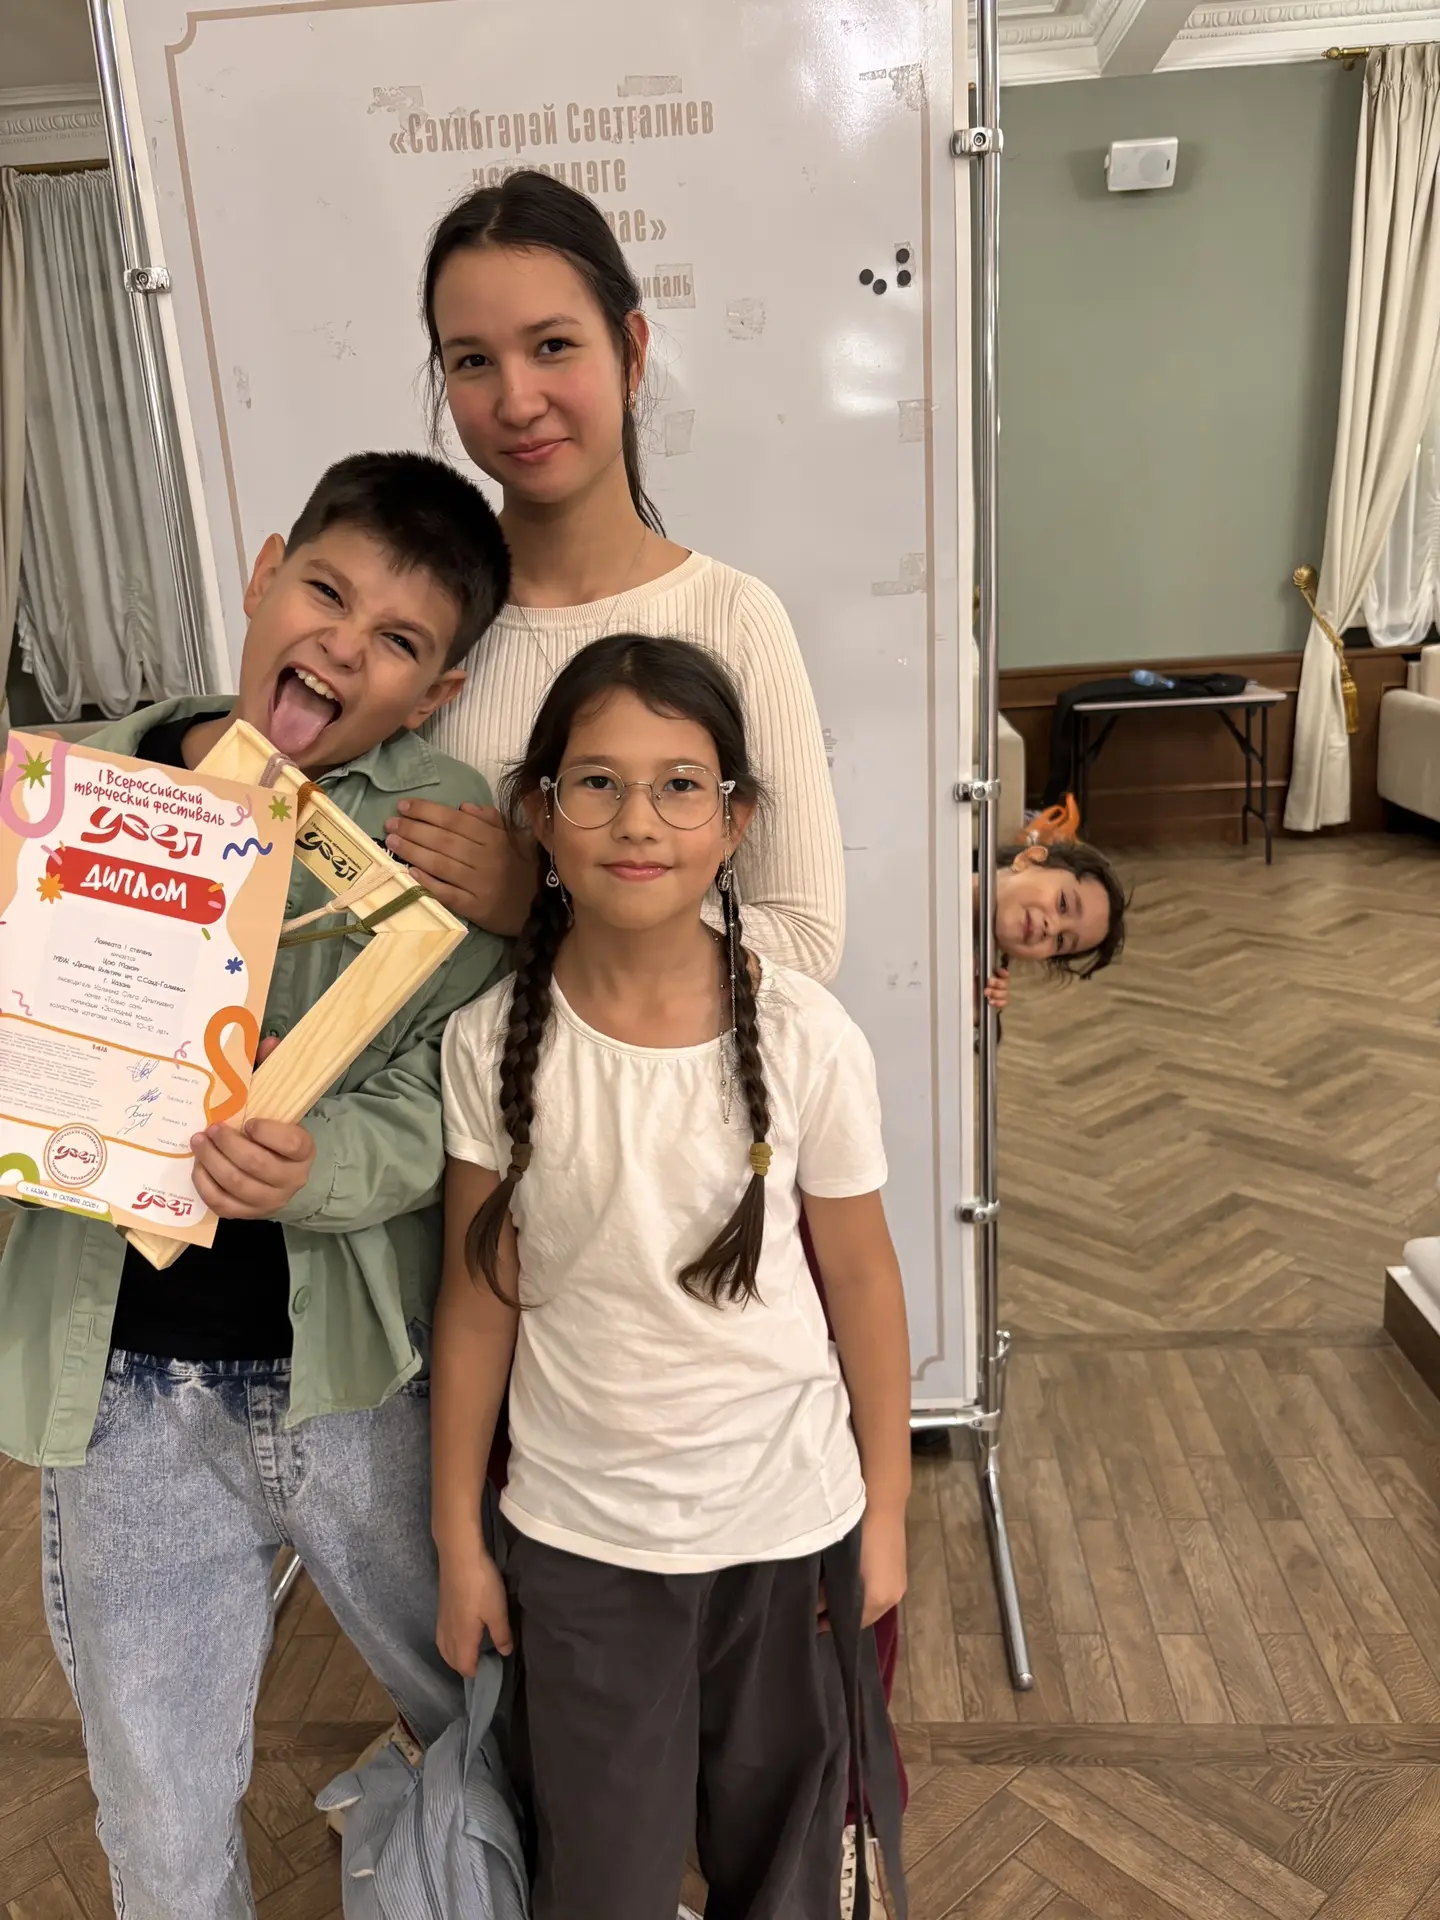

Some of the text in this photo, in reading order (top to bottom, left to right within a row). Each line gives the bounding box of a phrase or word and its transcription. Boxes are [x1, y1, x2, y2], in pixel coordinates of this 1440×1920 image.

[389, 101, 714, 154] «Сәхибгәрәй Сәетгалиев
[74, 782, 225, 827] творческий фестиваль
[106, 769, 203, 806] Всероссийский
[80, 863, 187, 910] ДИПЛОМ
